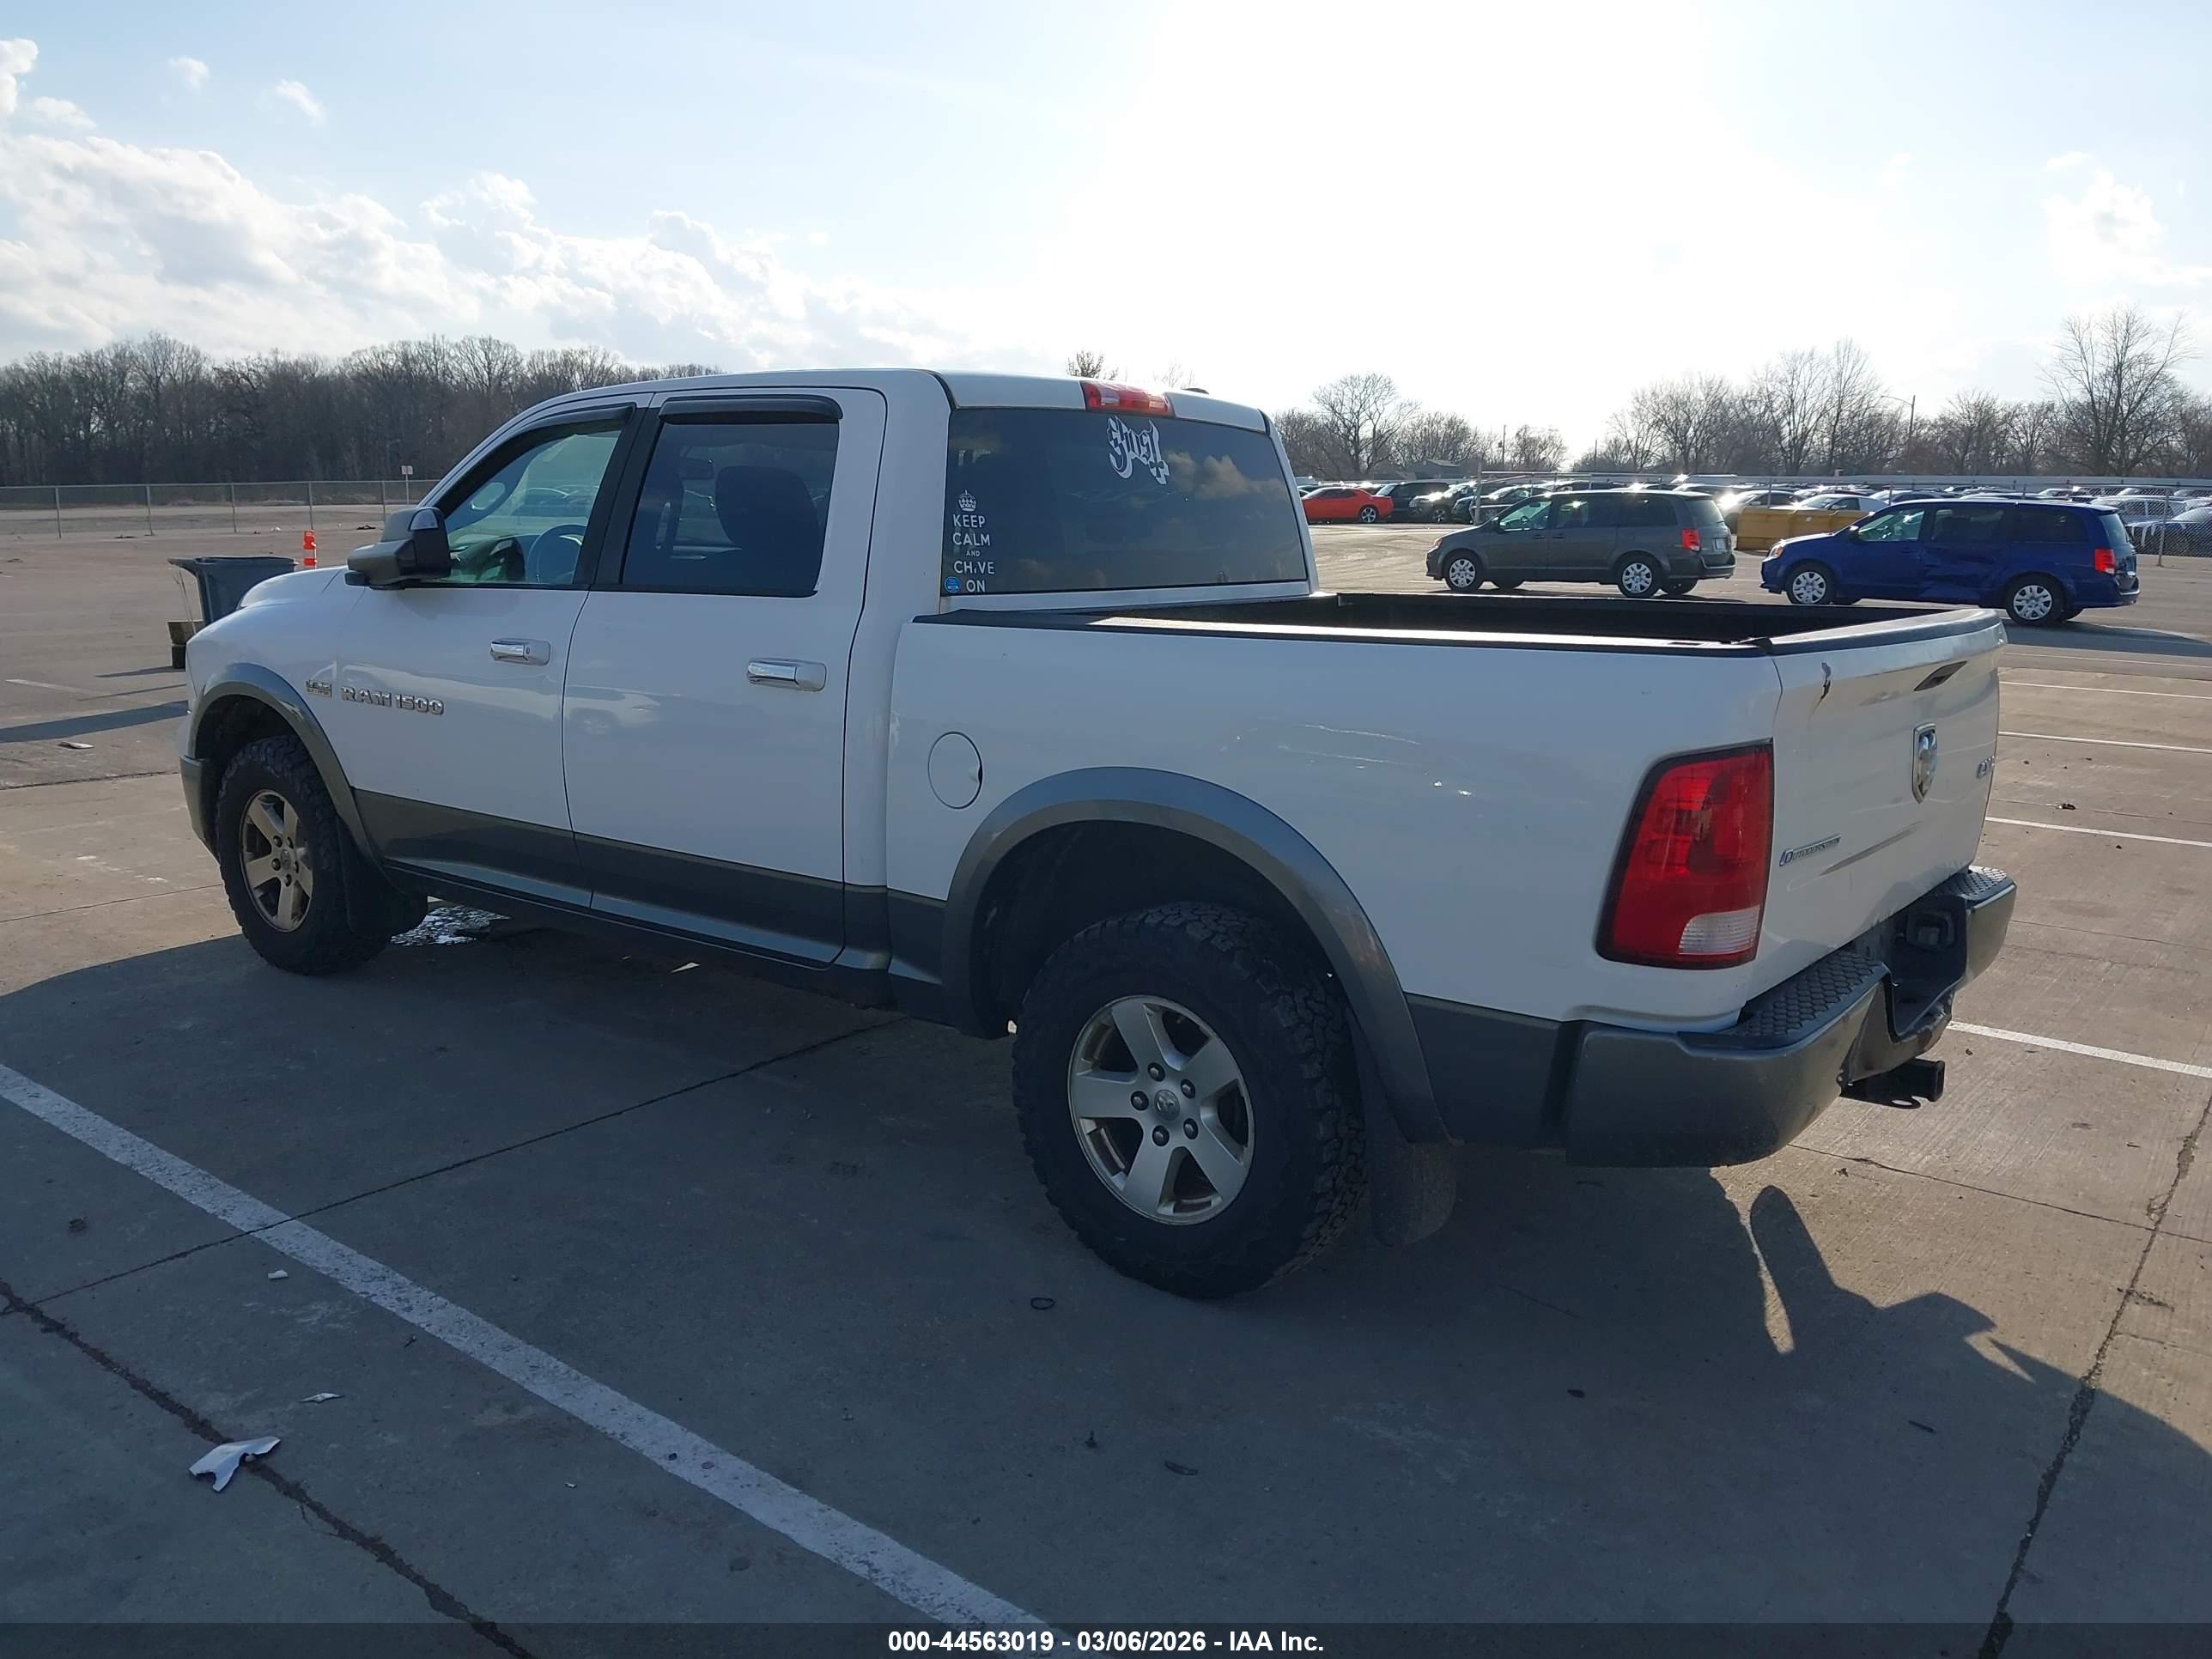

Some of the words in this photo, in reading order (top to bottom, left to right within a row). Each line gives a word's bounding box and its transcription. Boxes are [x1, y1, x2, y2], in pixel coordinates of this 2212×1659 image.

[953, 514, 986, 528] KEEP
[952, 532, 991, 546] CALM
[966, 580, 987, 592] ON
[341, 686, 392, 708] RAM
[395, 694, 445, 715] 1500
